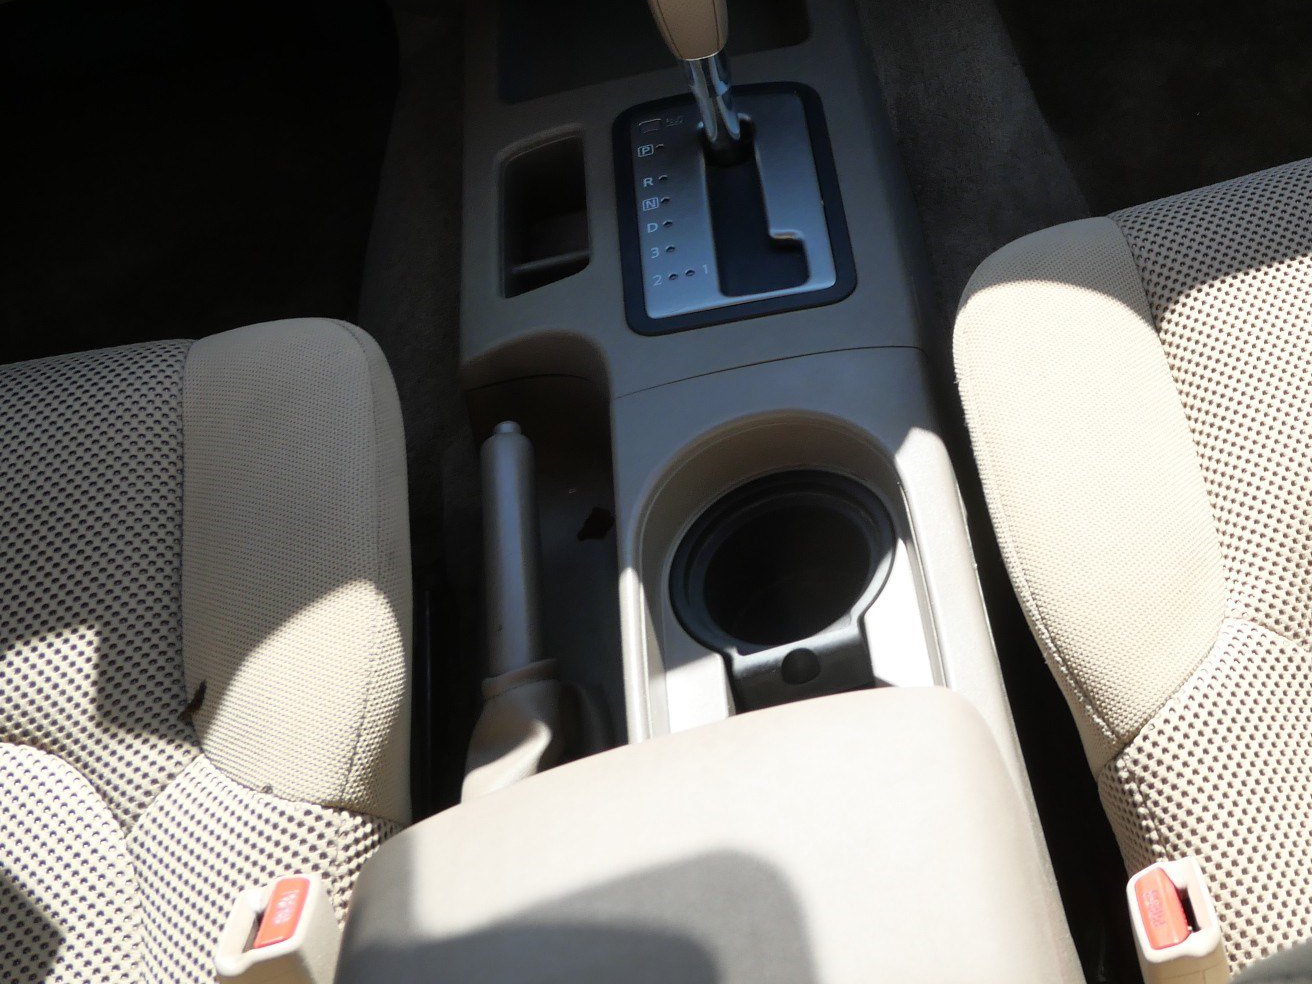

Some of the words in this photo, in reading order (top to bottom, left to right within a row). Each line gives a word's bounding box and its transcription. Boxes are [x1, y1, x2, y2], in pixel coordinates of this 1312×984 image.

[643, 177, 654, 188] R
[647, 223, 659, 233] D
[651, 247, 660, 258] 3
[702, 264, 708, 274] 1
[652, 275, 663, 286] 2
